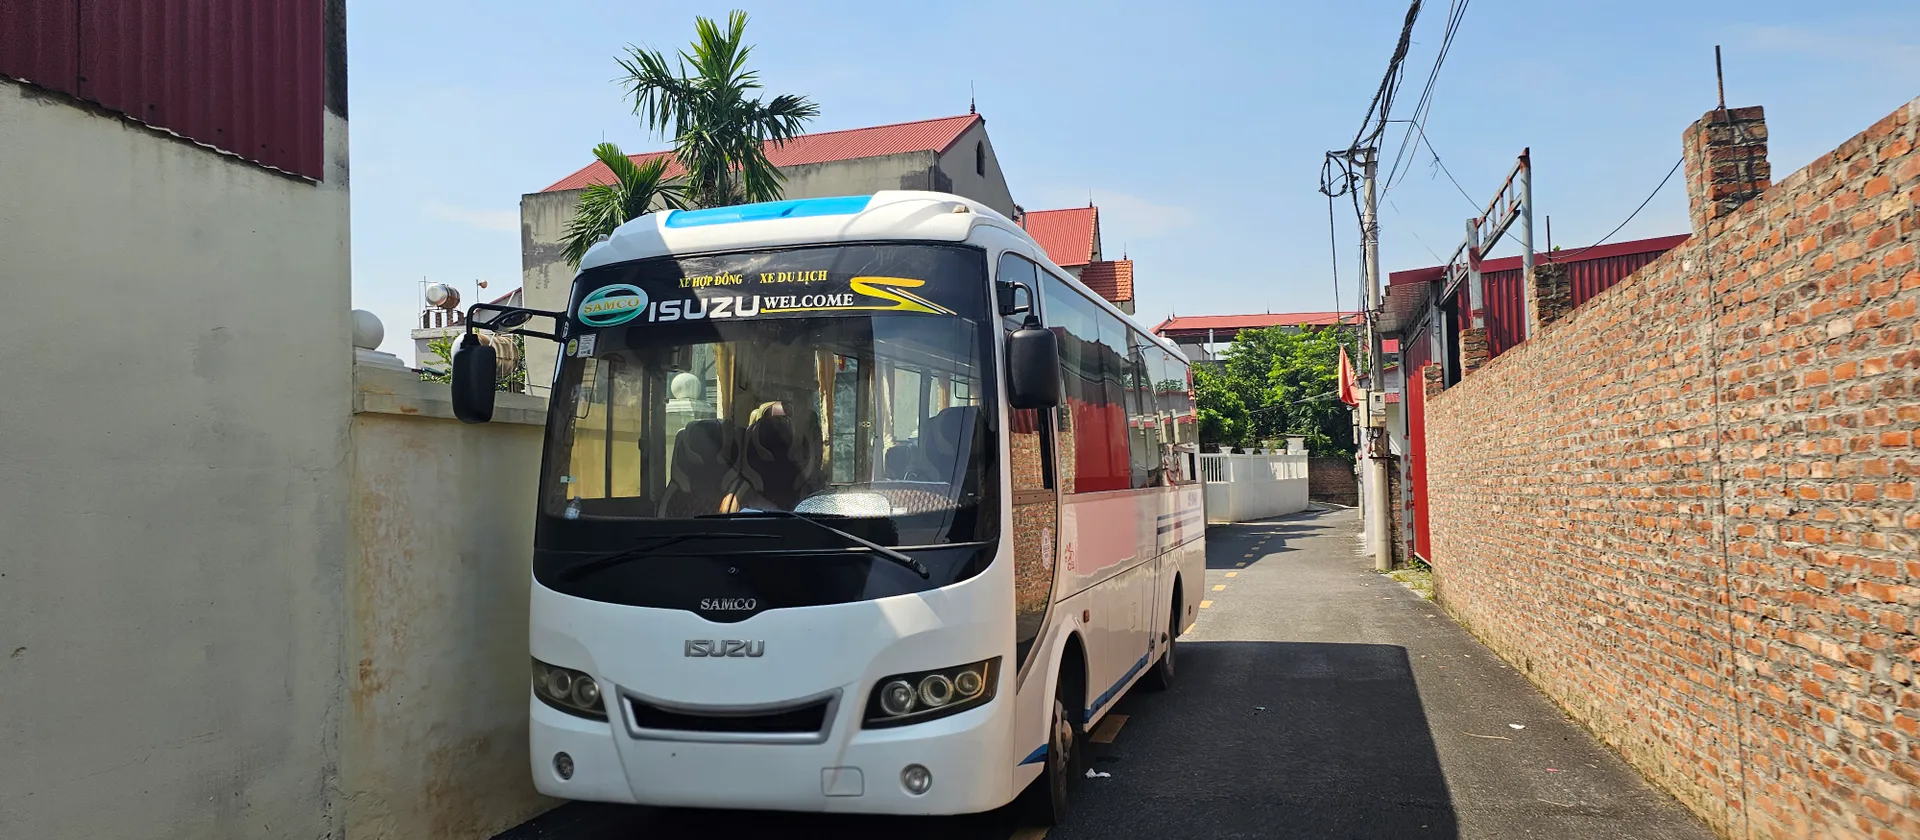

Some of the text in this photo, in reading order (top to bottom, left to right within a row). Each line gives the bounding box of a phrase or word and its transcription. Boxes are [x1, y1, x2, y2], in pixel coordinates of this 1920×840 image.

[679, 277, 690, 288] XE
[692, 275, 713, 289] HỢP
[759, 270, 828, 285] XE DU LỊCH
[584, 298, 640, 314] SAMCO
[648, 295, 761, 323] ISUZU
[764, 293, 854, 309] WELCOME
[700, 598, 757, 611] SAMCO
[684, 639, 765, 658] ISUZU
